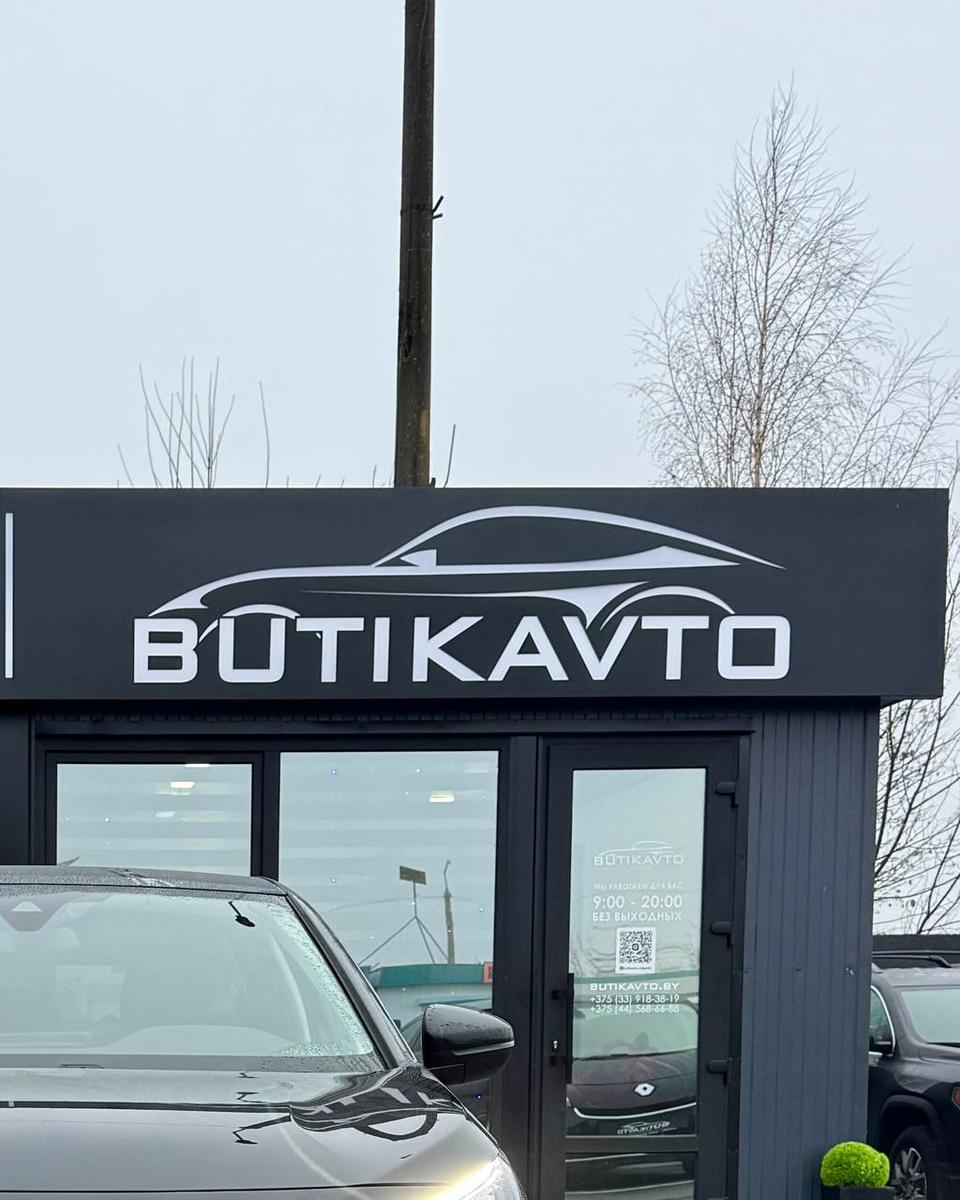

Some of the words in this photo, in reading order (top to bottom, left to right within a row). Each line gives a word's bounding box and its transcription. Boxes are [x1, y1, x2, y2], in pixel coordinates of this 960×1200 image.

[133, 615, 791, 683] BUTIKAVTO
[594, 854, 684, 865] BUTIKAVTO
[593, 895, 625, 909] 9:00
[641, 895, 682, 908] 20:00
[592, 911, 611, 922] БЕЗ
[614, 911, 682, 922] ВЫХОДНЫХ
[590, 982, 680, 991] BUTIKAVTO.BY
[591, 994, 612, 1004] +375
[615, 994, 632, 1004] (33)
[635, 994, 680, 1004] 918-38-19
[591, 1004, 612, 1013] +375
